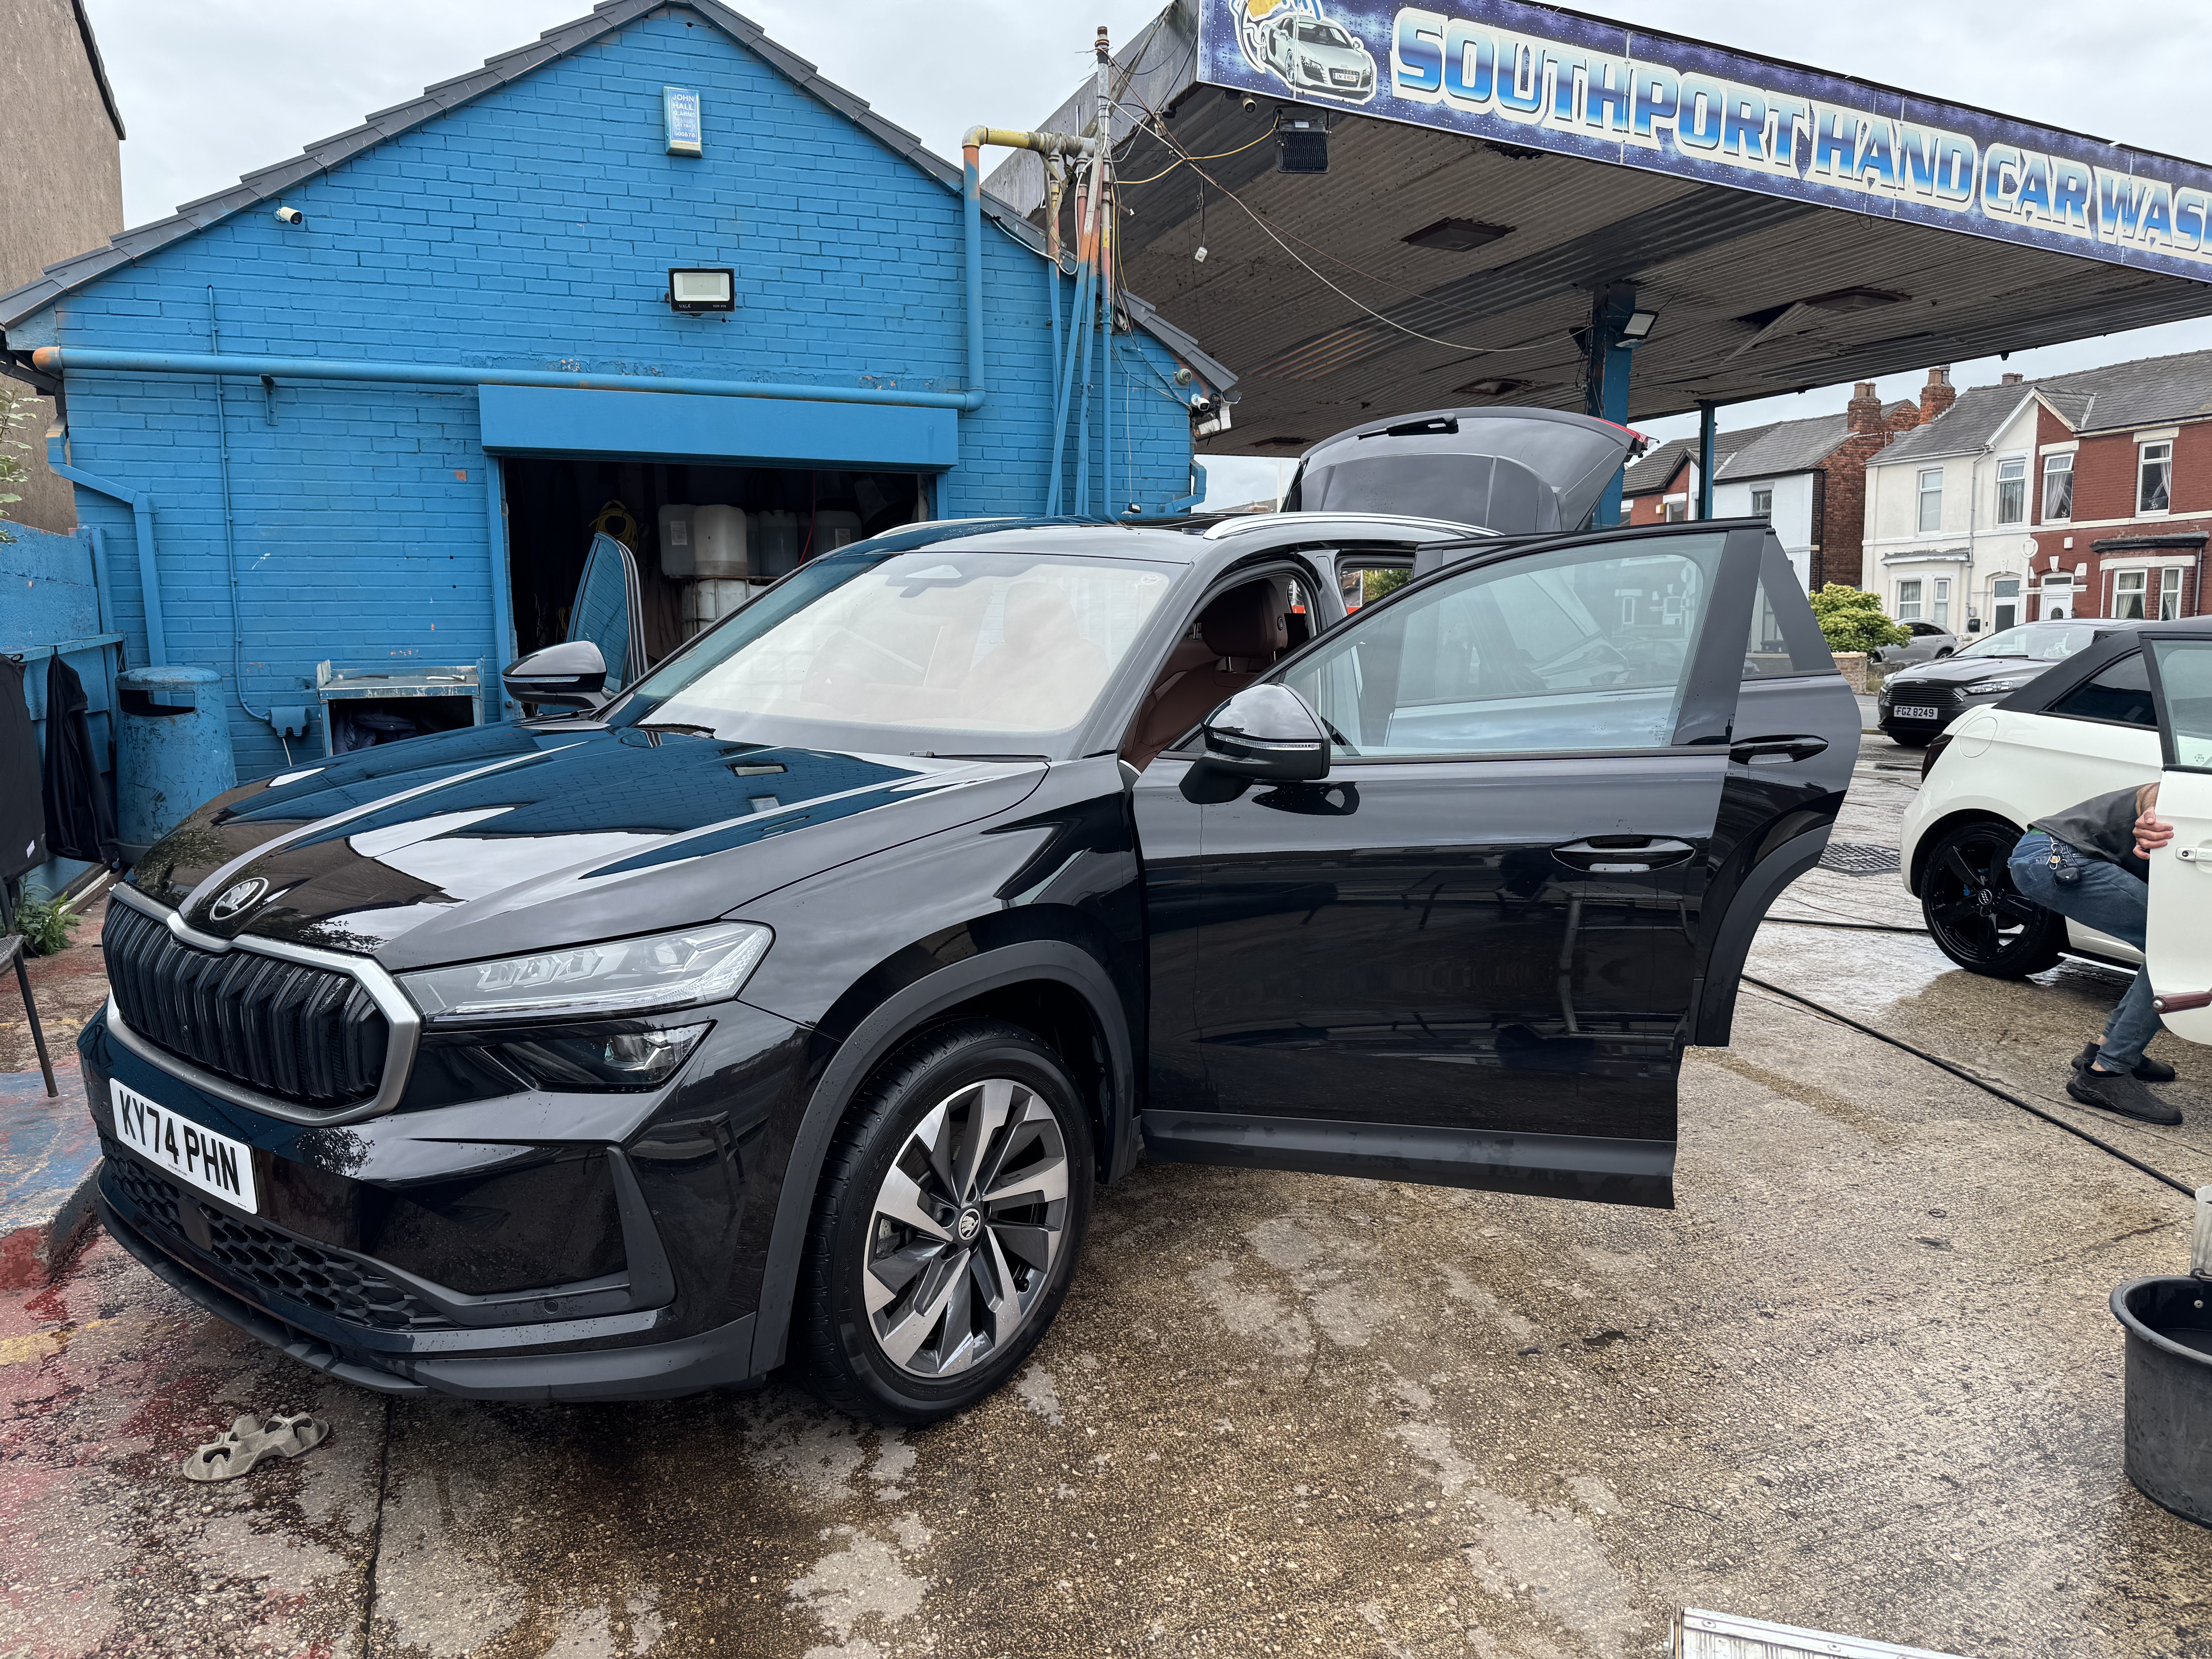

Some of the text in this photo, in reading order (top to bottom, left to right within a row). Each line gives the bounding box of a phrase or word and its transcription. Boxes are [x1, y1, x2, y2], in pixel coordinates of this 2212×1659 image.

[672, 94, 694, 102] JOHN
[672, 102, 694, 111] HALL
[1396, 13, 2212, 256] SOUTHPORT HAND CAR WAS
[1897, 707, 1934, 717] FGZ 8249
[119, 1089, 240, 1196] KY74 PHN
